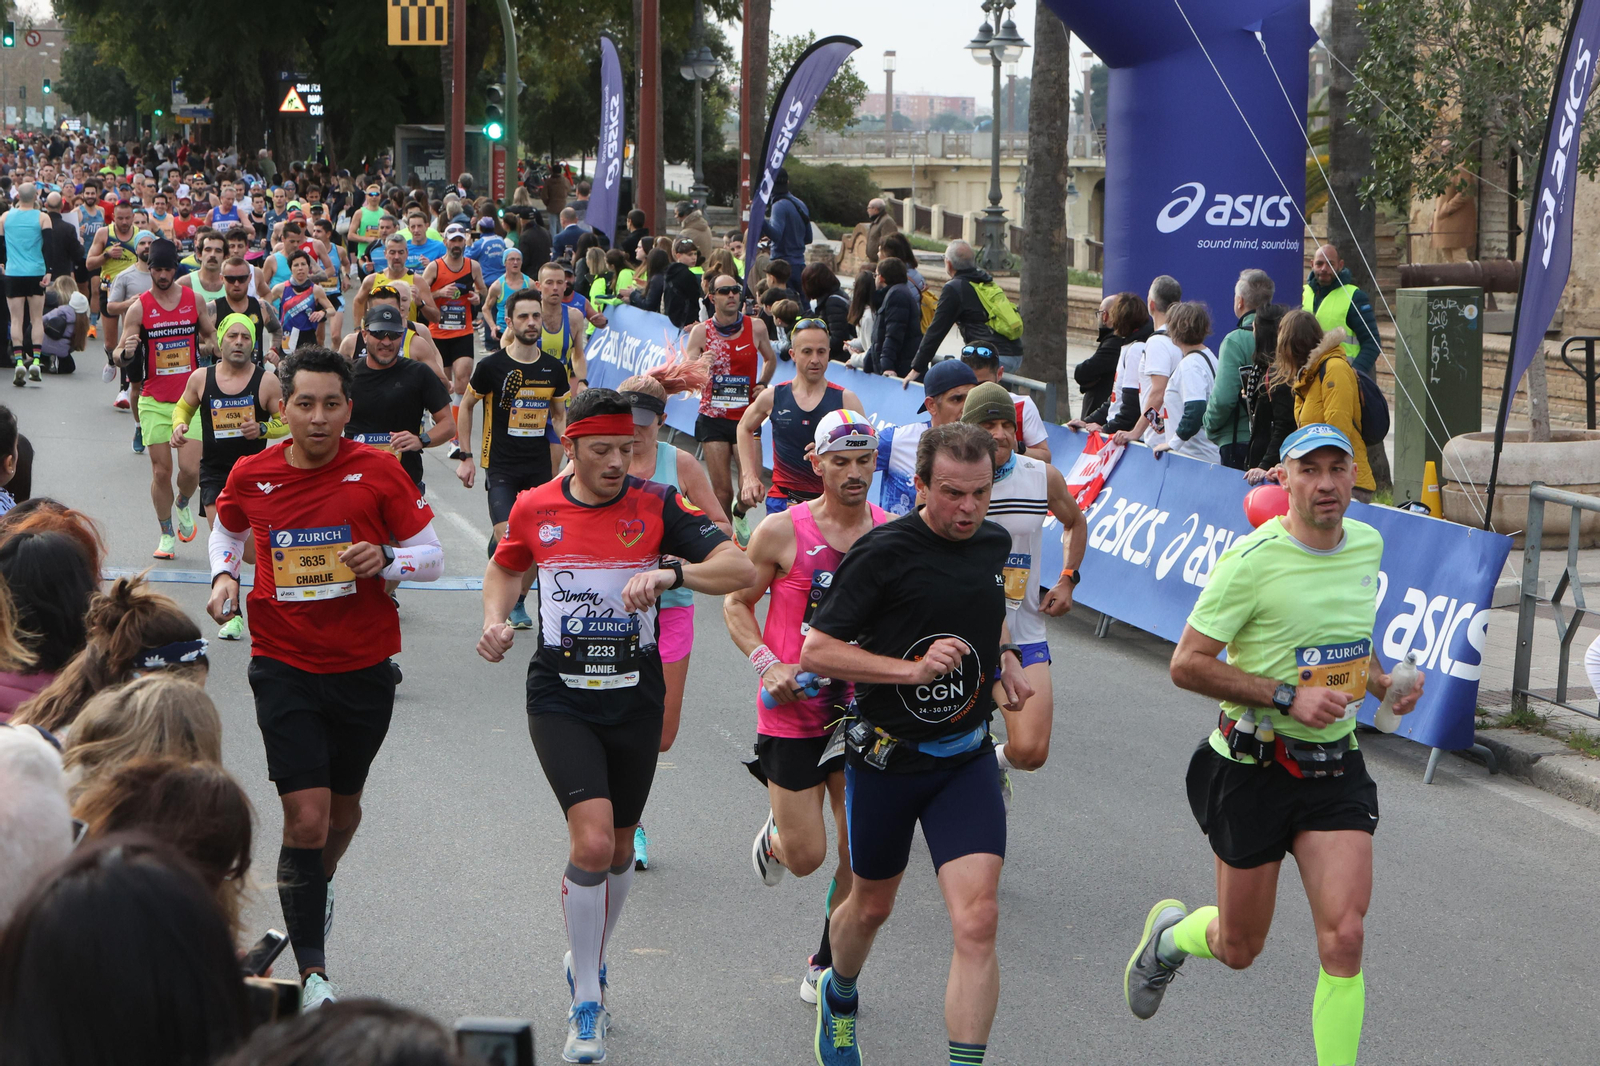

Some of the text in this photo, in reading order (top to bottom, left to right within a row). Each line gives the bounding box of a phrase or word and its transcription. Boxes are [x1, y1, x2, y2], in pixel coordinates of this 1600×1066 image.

[1551, 37, 1591, 195] asics
[770, 96, 803, 169] asics
[1205, 193, 1293, 227] asics
[1197, 237, 1299, 252] sound mind, sound body
[153, 320, 179, 329] atletismo
[148, 326, 196, 338] MANCHATHON
[165, 341, 186, 349] ZURICH
[224, 399, 249, 407] ZURICH
[297, 530, 342, 543] ZURICH
[1088, 497, 1170, 565] asics
[299, 555, 326, 567] 3635
[296, 573, 334, 585] CHARLIE
[552, 570, 604, 606] Simón
[588, 622, 634, 632] ZURICH
[1382, 587, 1491, 681] asics
[587, 645, 616, 657] 2233
[1326, 643, 1364, 660] ZURICH
[585, 664, 617, 674] DANIEL
[1325, 672, 1350, 686] 3807
[915, 680, 964, 702] CGN
[950, 700, 976, 724] DISTANCE
